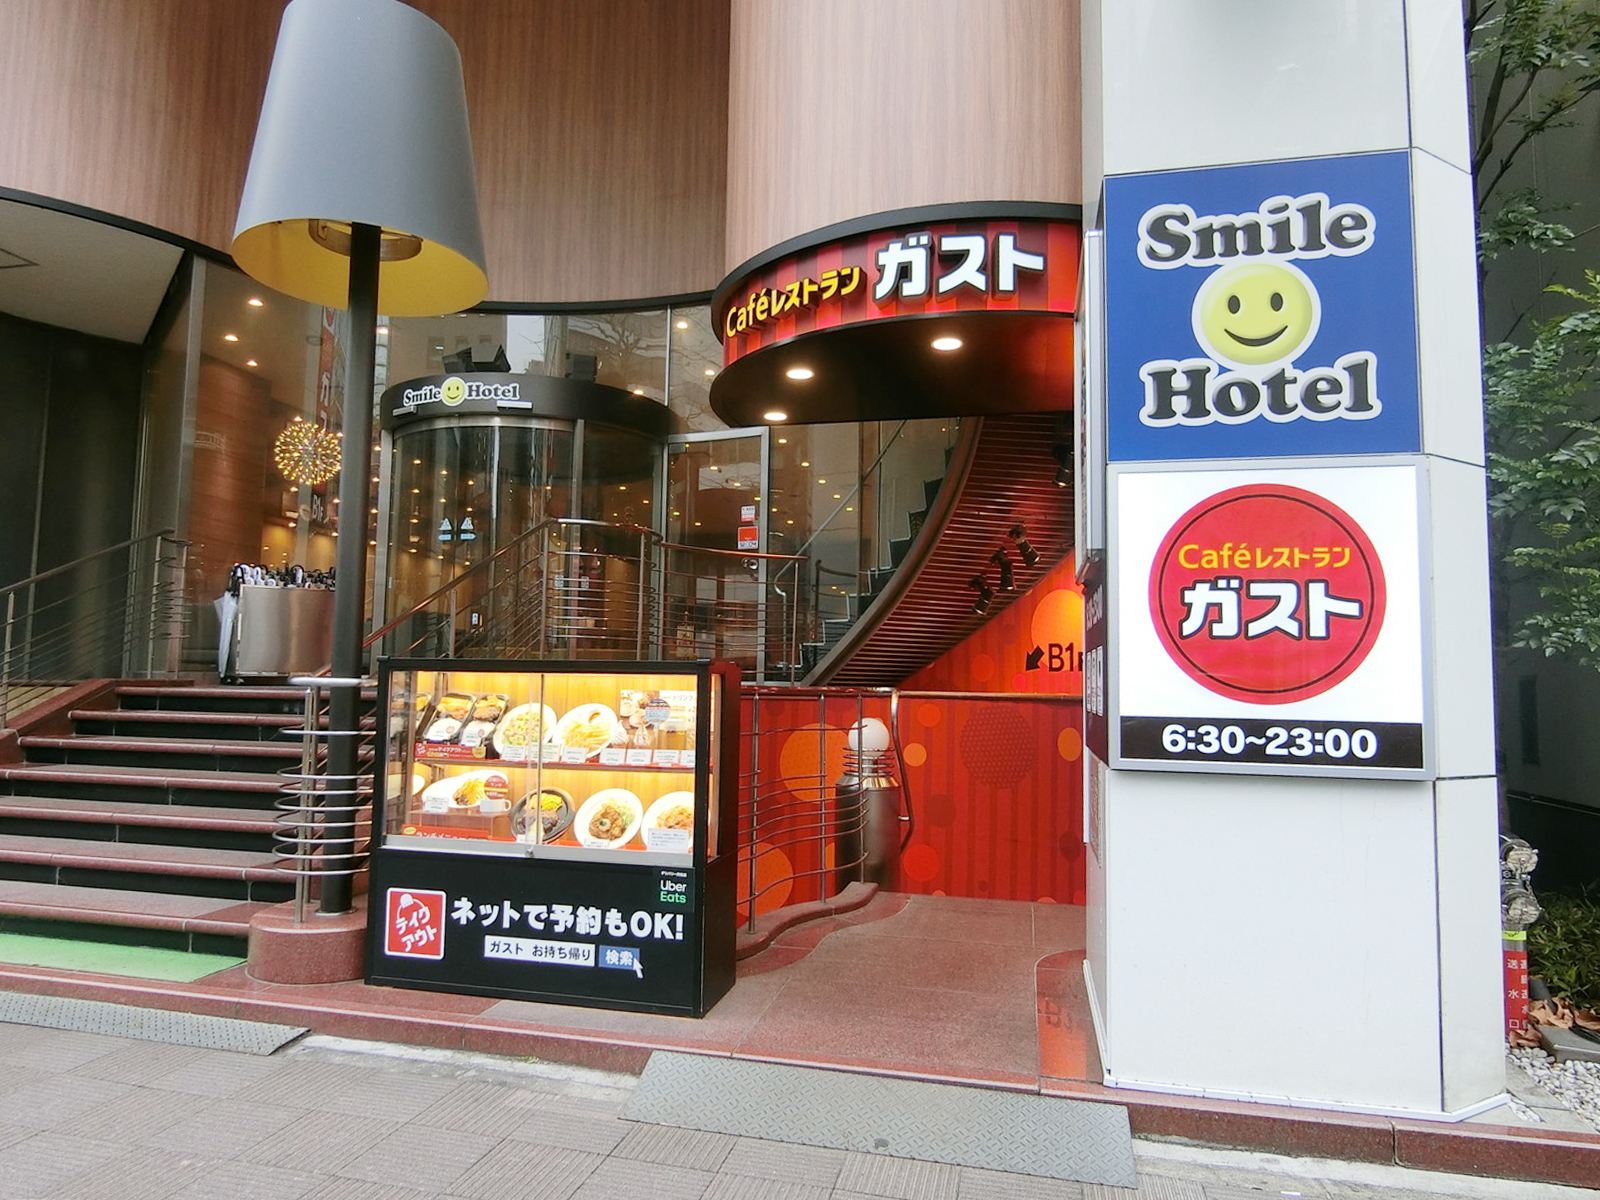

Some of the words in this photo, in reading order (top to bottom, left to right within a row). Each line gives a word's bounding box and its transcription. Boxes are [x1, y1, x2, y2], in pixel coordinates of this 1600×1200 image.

[1140, 196, 1372, 266] Smile
[873, 231, 1046, 300] ガスト
[403, 385, 441, 406] Smile
[464, 382, 520, 400] Hotel
[1142, 355, 1377, 423] Hotel
[1180, 576, 1362, 641] ガスト
[660, 879, 687, 892] Uber
[660, 891, 687, 904] Eats
[395, 906, 431, 935] テイク
[450, 897, 684, 941] ネットで予約もOK!
[400, 926, 438, 953] アウト
[489, 940, 524, 955] ガスト
[531, 944, 592, 961] お持ち帰り
[604, 949, 634, 967] 検索
[1506, 958, 1520, 1029] 送水口
